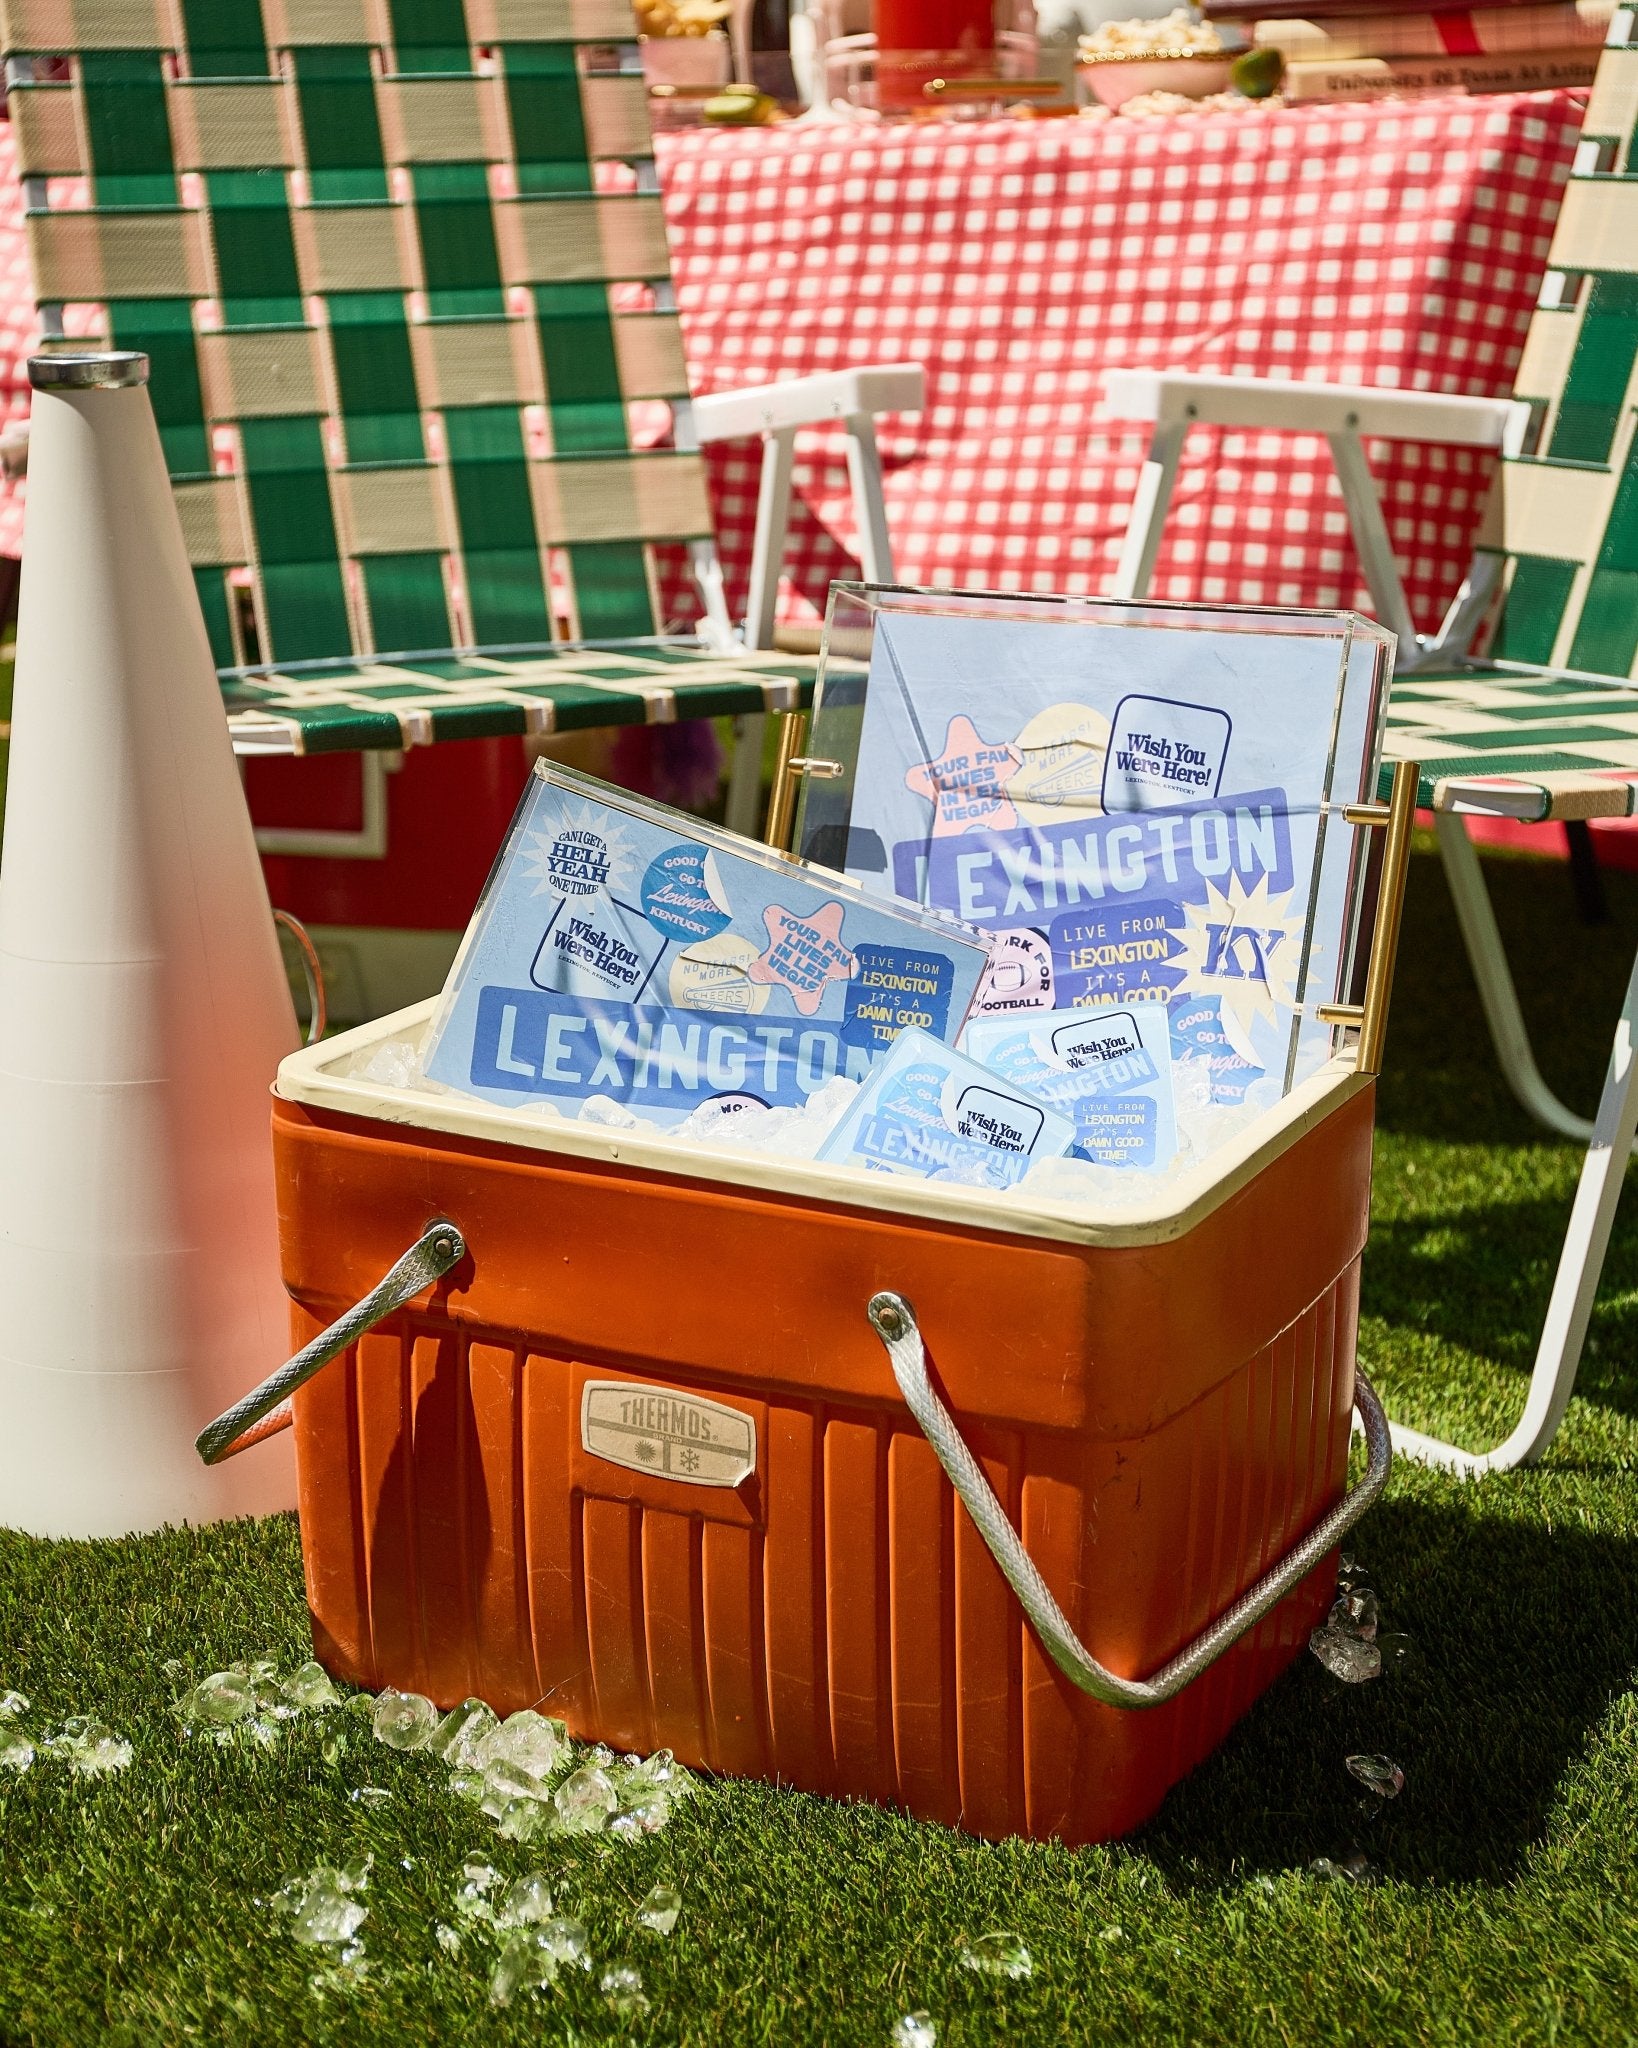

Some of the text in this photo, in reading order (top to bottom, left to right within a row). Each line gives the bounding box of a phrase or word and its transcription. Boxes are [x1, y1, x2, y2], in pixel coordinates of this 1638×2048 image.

[1127, 733, 1206, 766] Wish You
[922, 750, 1010, 781] YOUR FAV
[1115, 750, 1212, 786] Were Here!
[939, 766, 996, 791] LIVES
[940, 782, 1001, 807] IN LEX
[942, 799, 1003, 822] VEGAS
[558, 830, 607, 852] CAN I GET A
[550, 841, 612, 869] HELL
[663, 856, 699, 868] GOOD
[914, 805, 1279, 920] LEXINGTON
[547, 856, 610, 884] YEAH
[679, 872, 696, 885] GO
[549, 874, 599, 895] ONE TIME
[649, 905, 711, 936] KENTUCKY
[1063, 915, 1166, 942] LIVE FROM
[568, 917, 640, 968] Wish You
[779, 915, 850, 968] YOUR FAV
[784, 932, 833, 970] LIVES
[1200, 922, 1287, 983] KY
[554, 929, 641, 986] Were Here!
[774, 942, 828, 982] IN LEX
[861, 954, 940, 976] LIVE FROM
[1070, 938, 1168, 970] LEXINGTON
[683, 963, 699, 974] NO
[699, 967, 732, 981] MORE
[768, 954, 820, 991] VEGAS
[1034, 952, 1051, 991] FOR
[1085, 969, 1151, 990] IT'S A
[591, 971, 622, 990] KENTUCKY
[862, 970, 938, 996] LEXINGTON
[693, 990, 744, 1003] CHEERS
[870, 992, 920, 1009] IT'S A
[981, 998, 1044, 1010] OOTBALL
[1123, 985, 1172, 1005] GOOD
[856, 1003, 933, 1028] DAMN GOOD
[1177, 1010, 1214, 1030] GOOD
[872, 1024, 902, 1042] TIM
[1196, 1031, 1216, 1043] GO
[496, 1004, 885, 1095] LEXINGTON
[995, 1042, 1026, 1061] GOOD
[1066, 1043, 1136, 1069] Were Here!
[1067, 1036, 1128, 1058] Wish You
[1014, 1057, 1030, 1066] GO
[905, 1073, 939, 1085] GOOD
[917, 1088, 933, 1101] GO
[1082, 1103, 1145, 1112] LIVE FROM
[966, 1110, 1023, 1143] Wish You
[1085, 1114, 1145, 1125] LEXINGTON
[957, 1120, 1026, 1153] Were Here!
[1083, 1137, 1144, 1147] DAMN GOOD
[1126, 1128, 1133, 1136] A
[1096, 1150, 1127, 1160] TIME!
[653, 1433, 683, 1444] BRAND
